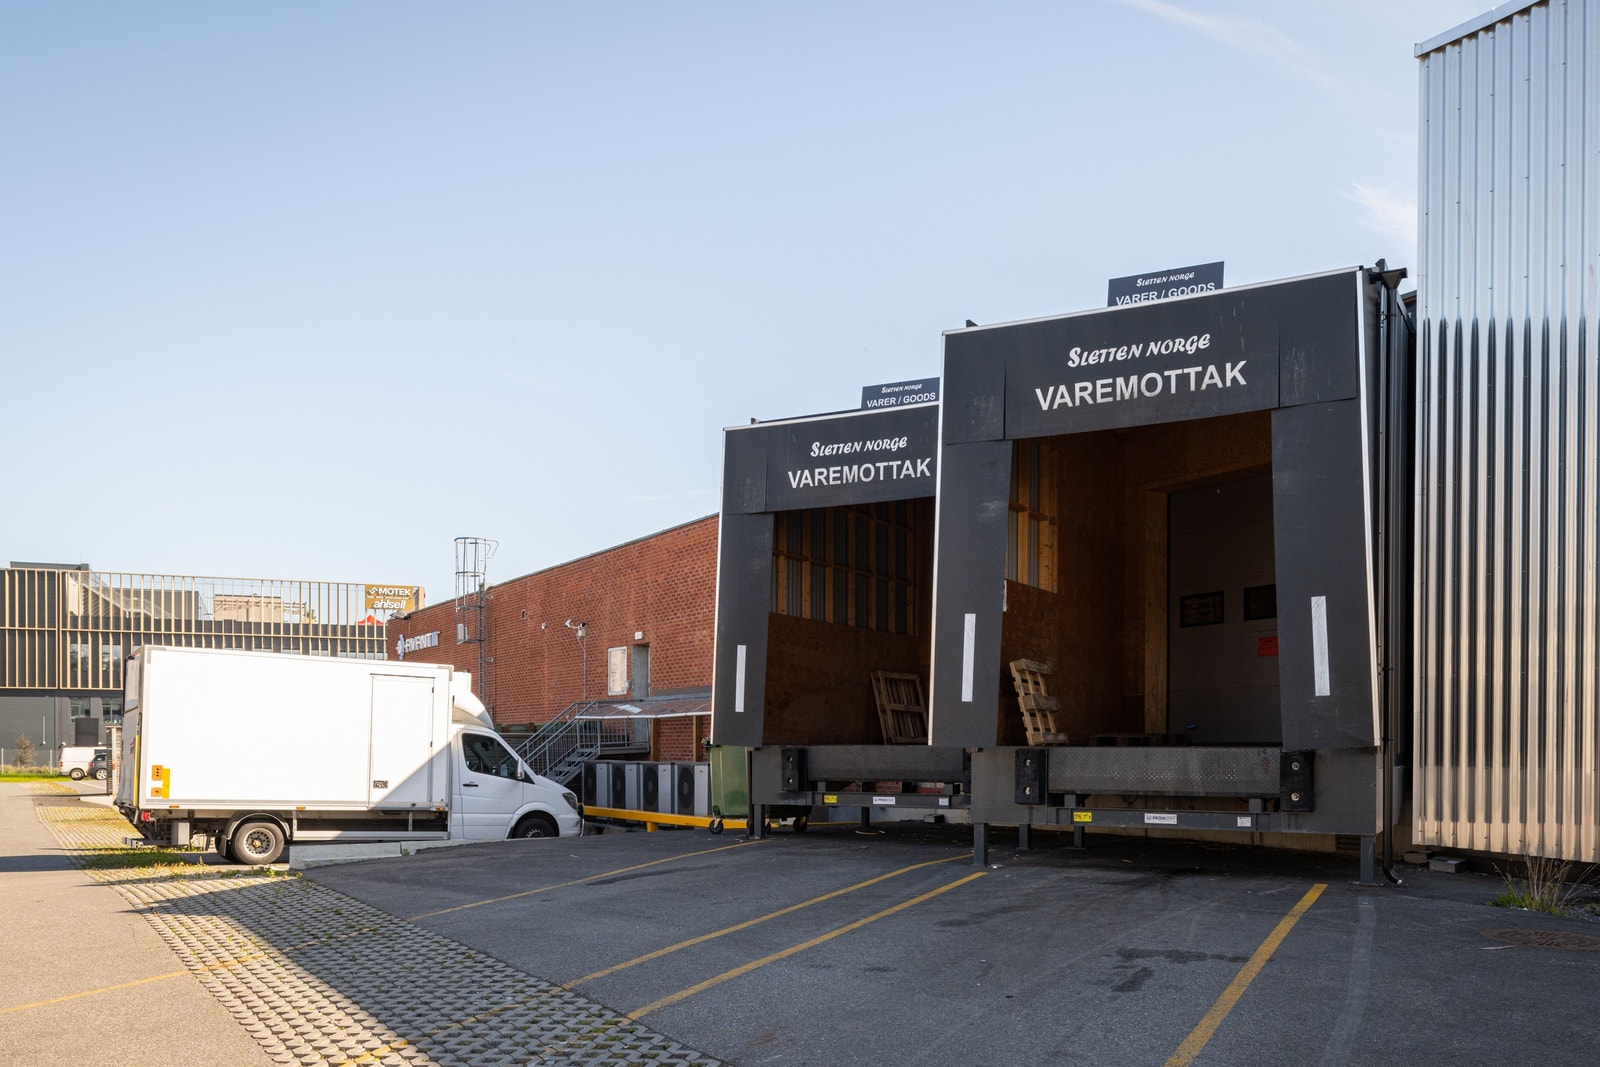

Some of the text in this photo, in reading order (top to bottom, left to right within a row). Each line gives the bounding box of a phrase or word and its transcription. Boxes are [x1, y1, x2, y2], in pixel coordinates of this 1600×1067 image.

[1115, 291, 1158, 306] VARER
[1168, 282, 1215, 298] GOODS
[1035, 360, 1247, 411] VAREMOTTAK
[866, 396, 897, 408] VARER
[903, 392, 936, 404] GOODS
[787, 457, 932, 489] VAREMOTTAK
[378, 587, 411, 596] MOTEK
[373, 599, 406, 609] ahlsell
